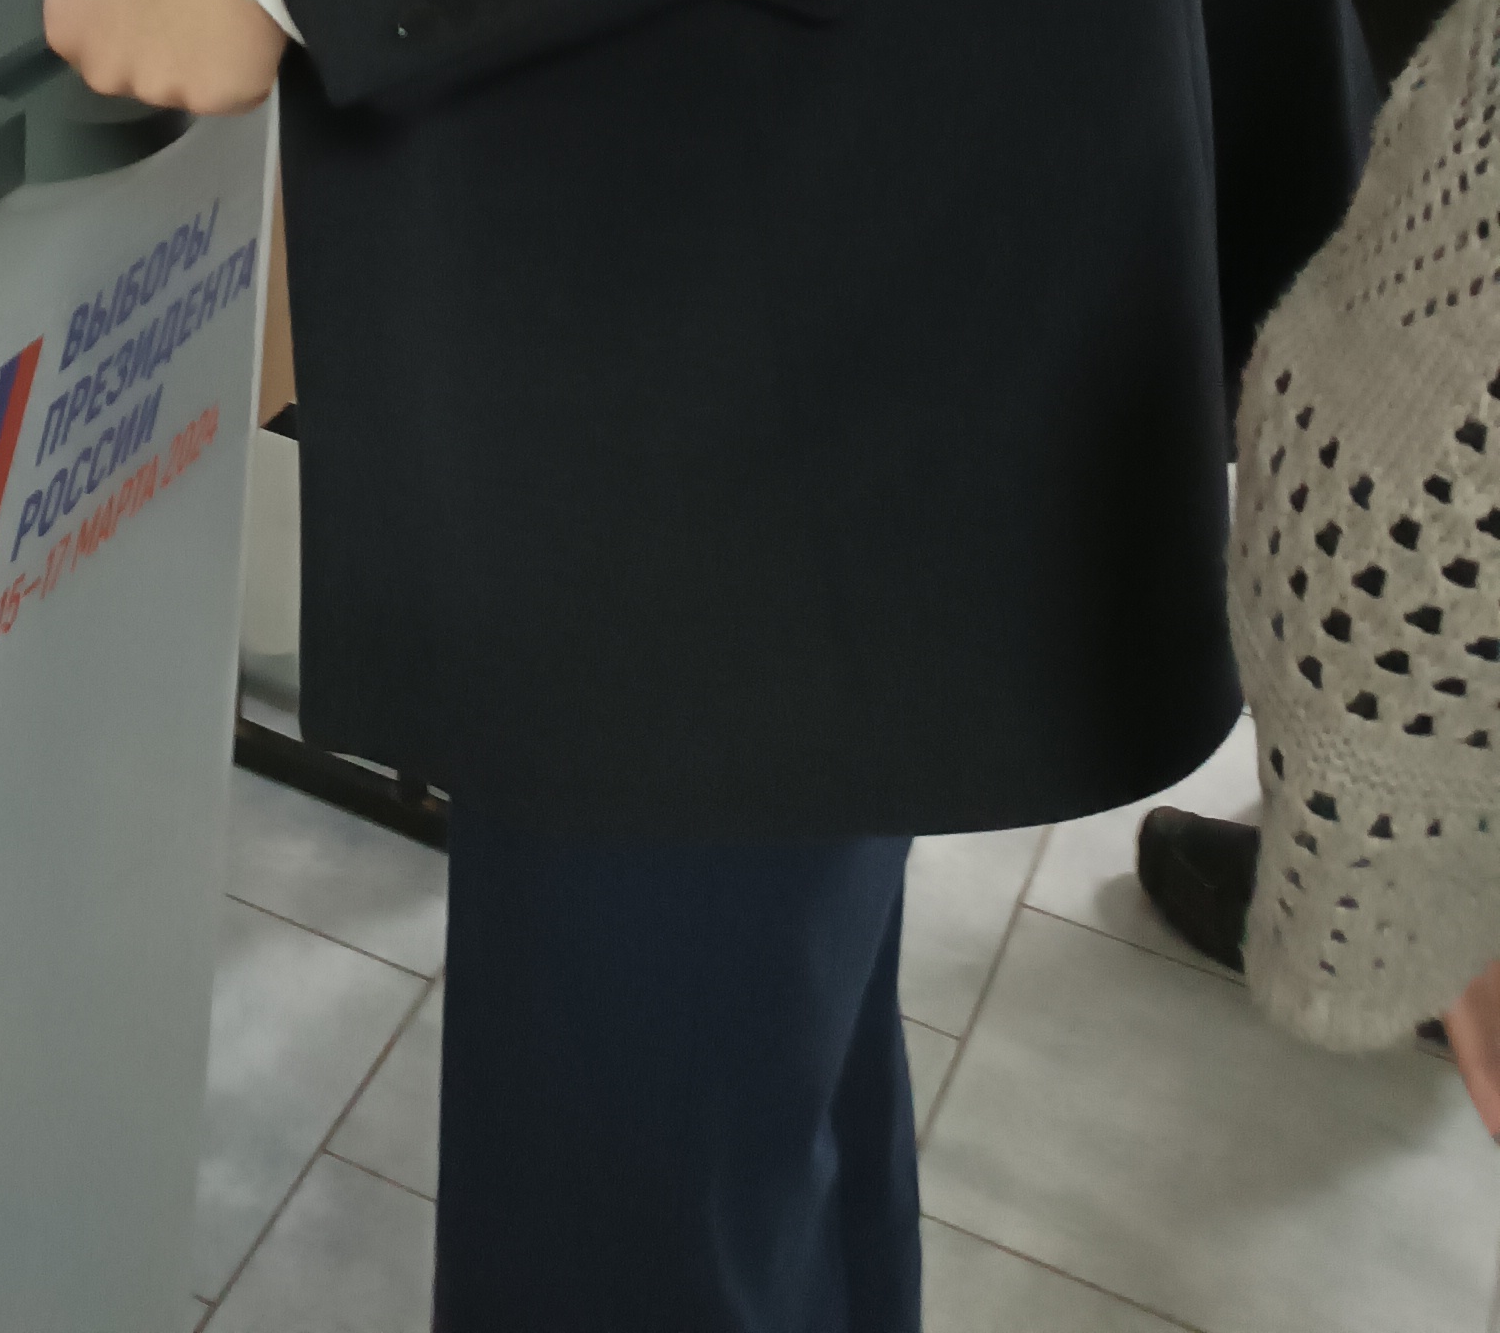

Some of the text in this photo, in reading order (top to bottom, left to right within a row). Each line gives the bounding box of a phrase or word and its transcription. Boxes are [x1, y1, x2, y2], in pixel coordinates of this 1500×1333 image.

[35, 238, 258, 467] ПРЕЗИДЕНТА
[59, 197, 220, 373] ВЫБОРЫ
[11, 384, 164, 563] РОССИИ
[70, 454, 160, 573] МАРТА
